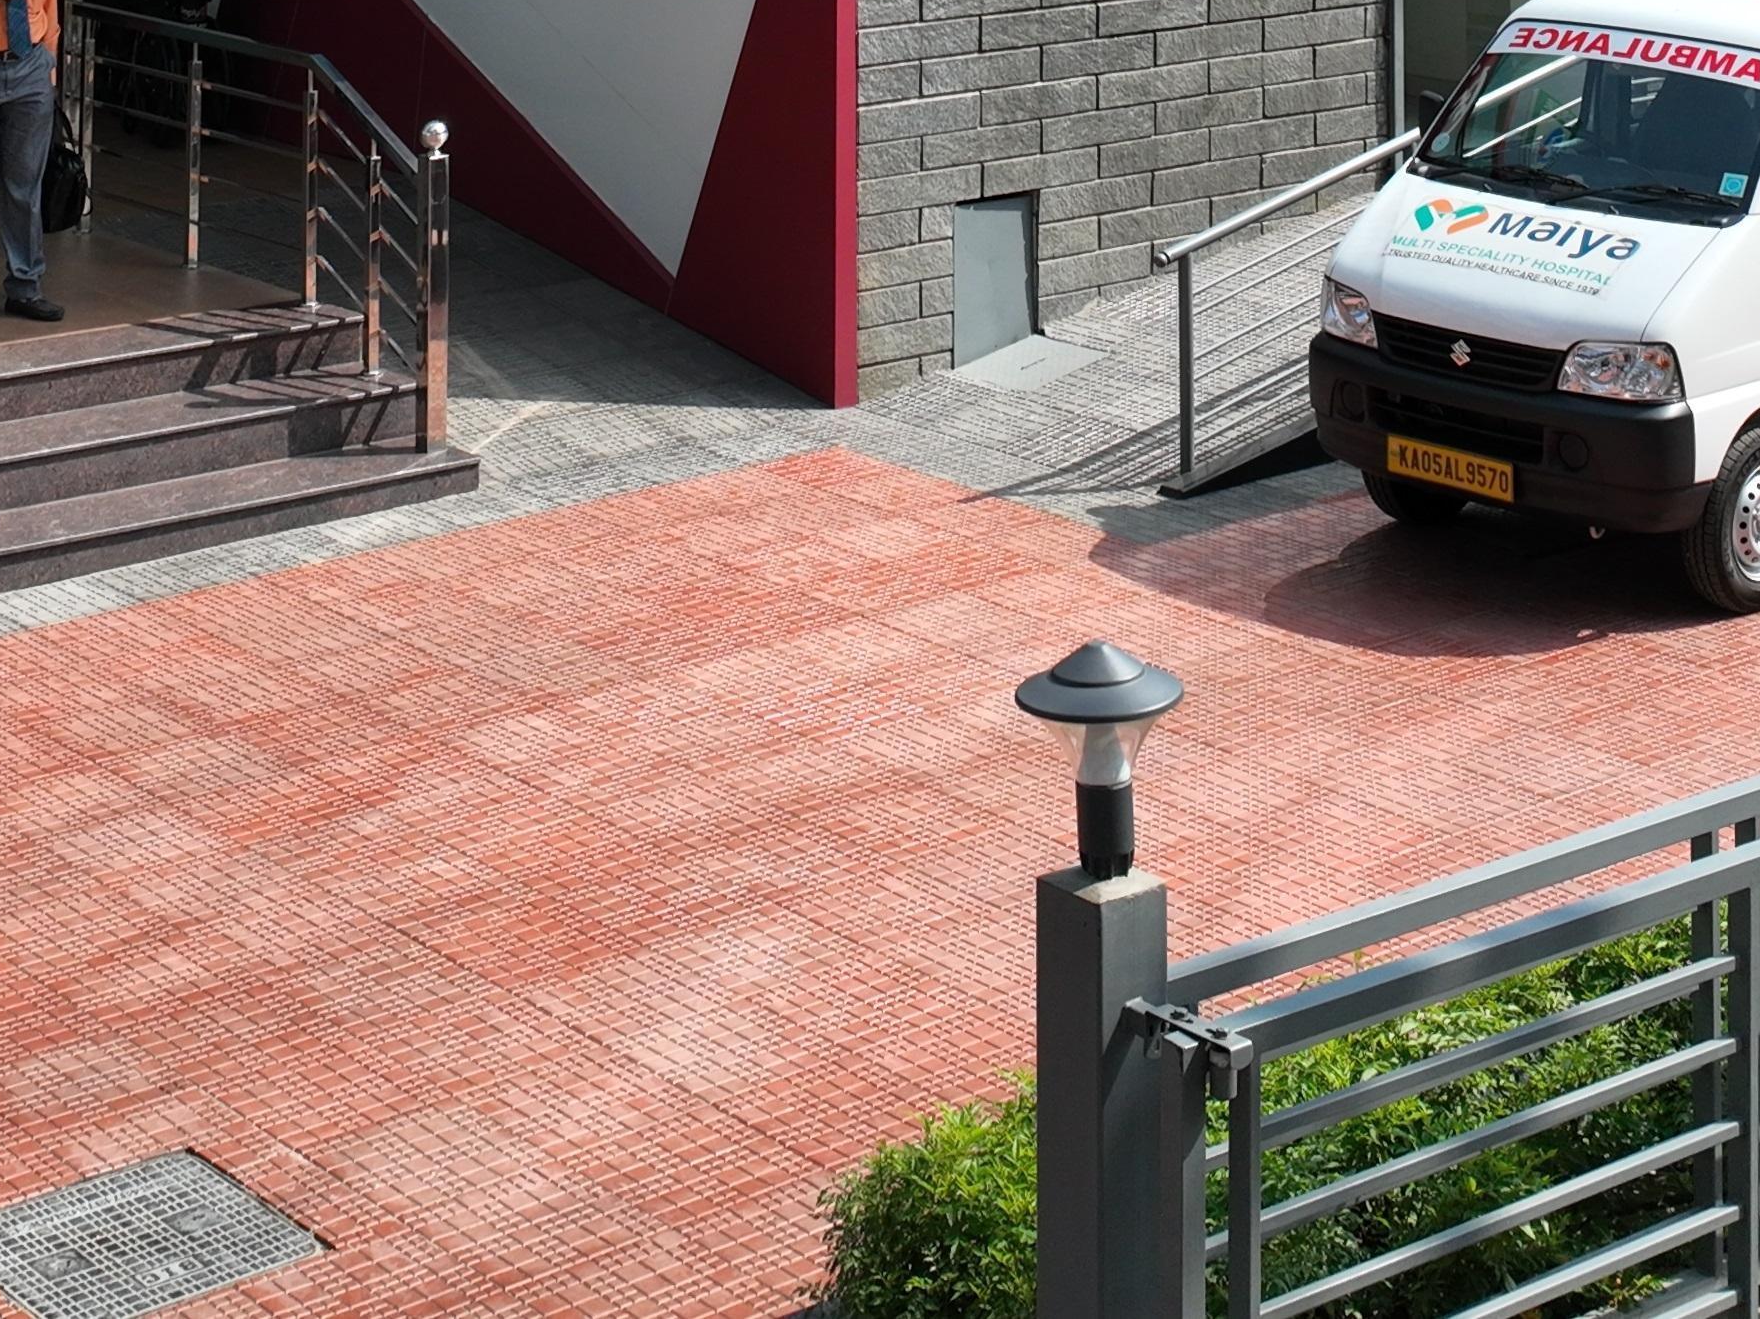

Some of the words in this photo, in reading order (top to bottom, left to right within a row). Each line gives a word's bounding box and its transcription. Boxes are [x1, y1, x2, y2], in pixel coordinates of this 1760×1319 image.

[1391, 235, 1435, 249] MULTI
[1437, 242, 1527, 265] SPECIALITY
[1531, 259, 1611, 285] HOSPITAL
[1488, 212, 1641, 260] Maiya
[1388, 249, 1429, 260] TRUSTED
[1431, 255, 1473, 267] QUALITY
[1474, 263, 1541, 282] HEALTHCARE
[1544, 276, 1574, 289] SINCE
[1399, 445, 1509, 493] KA05AL9570
